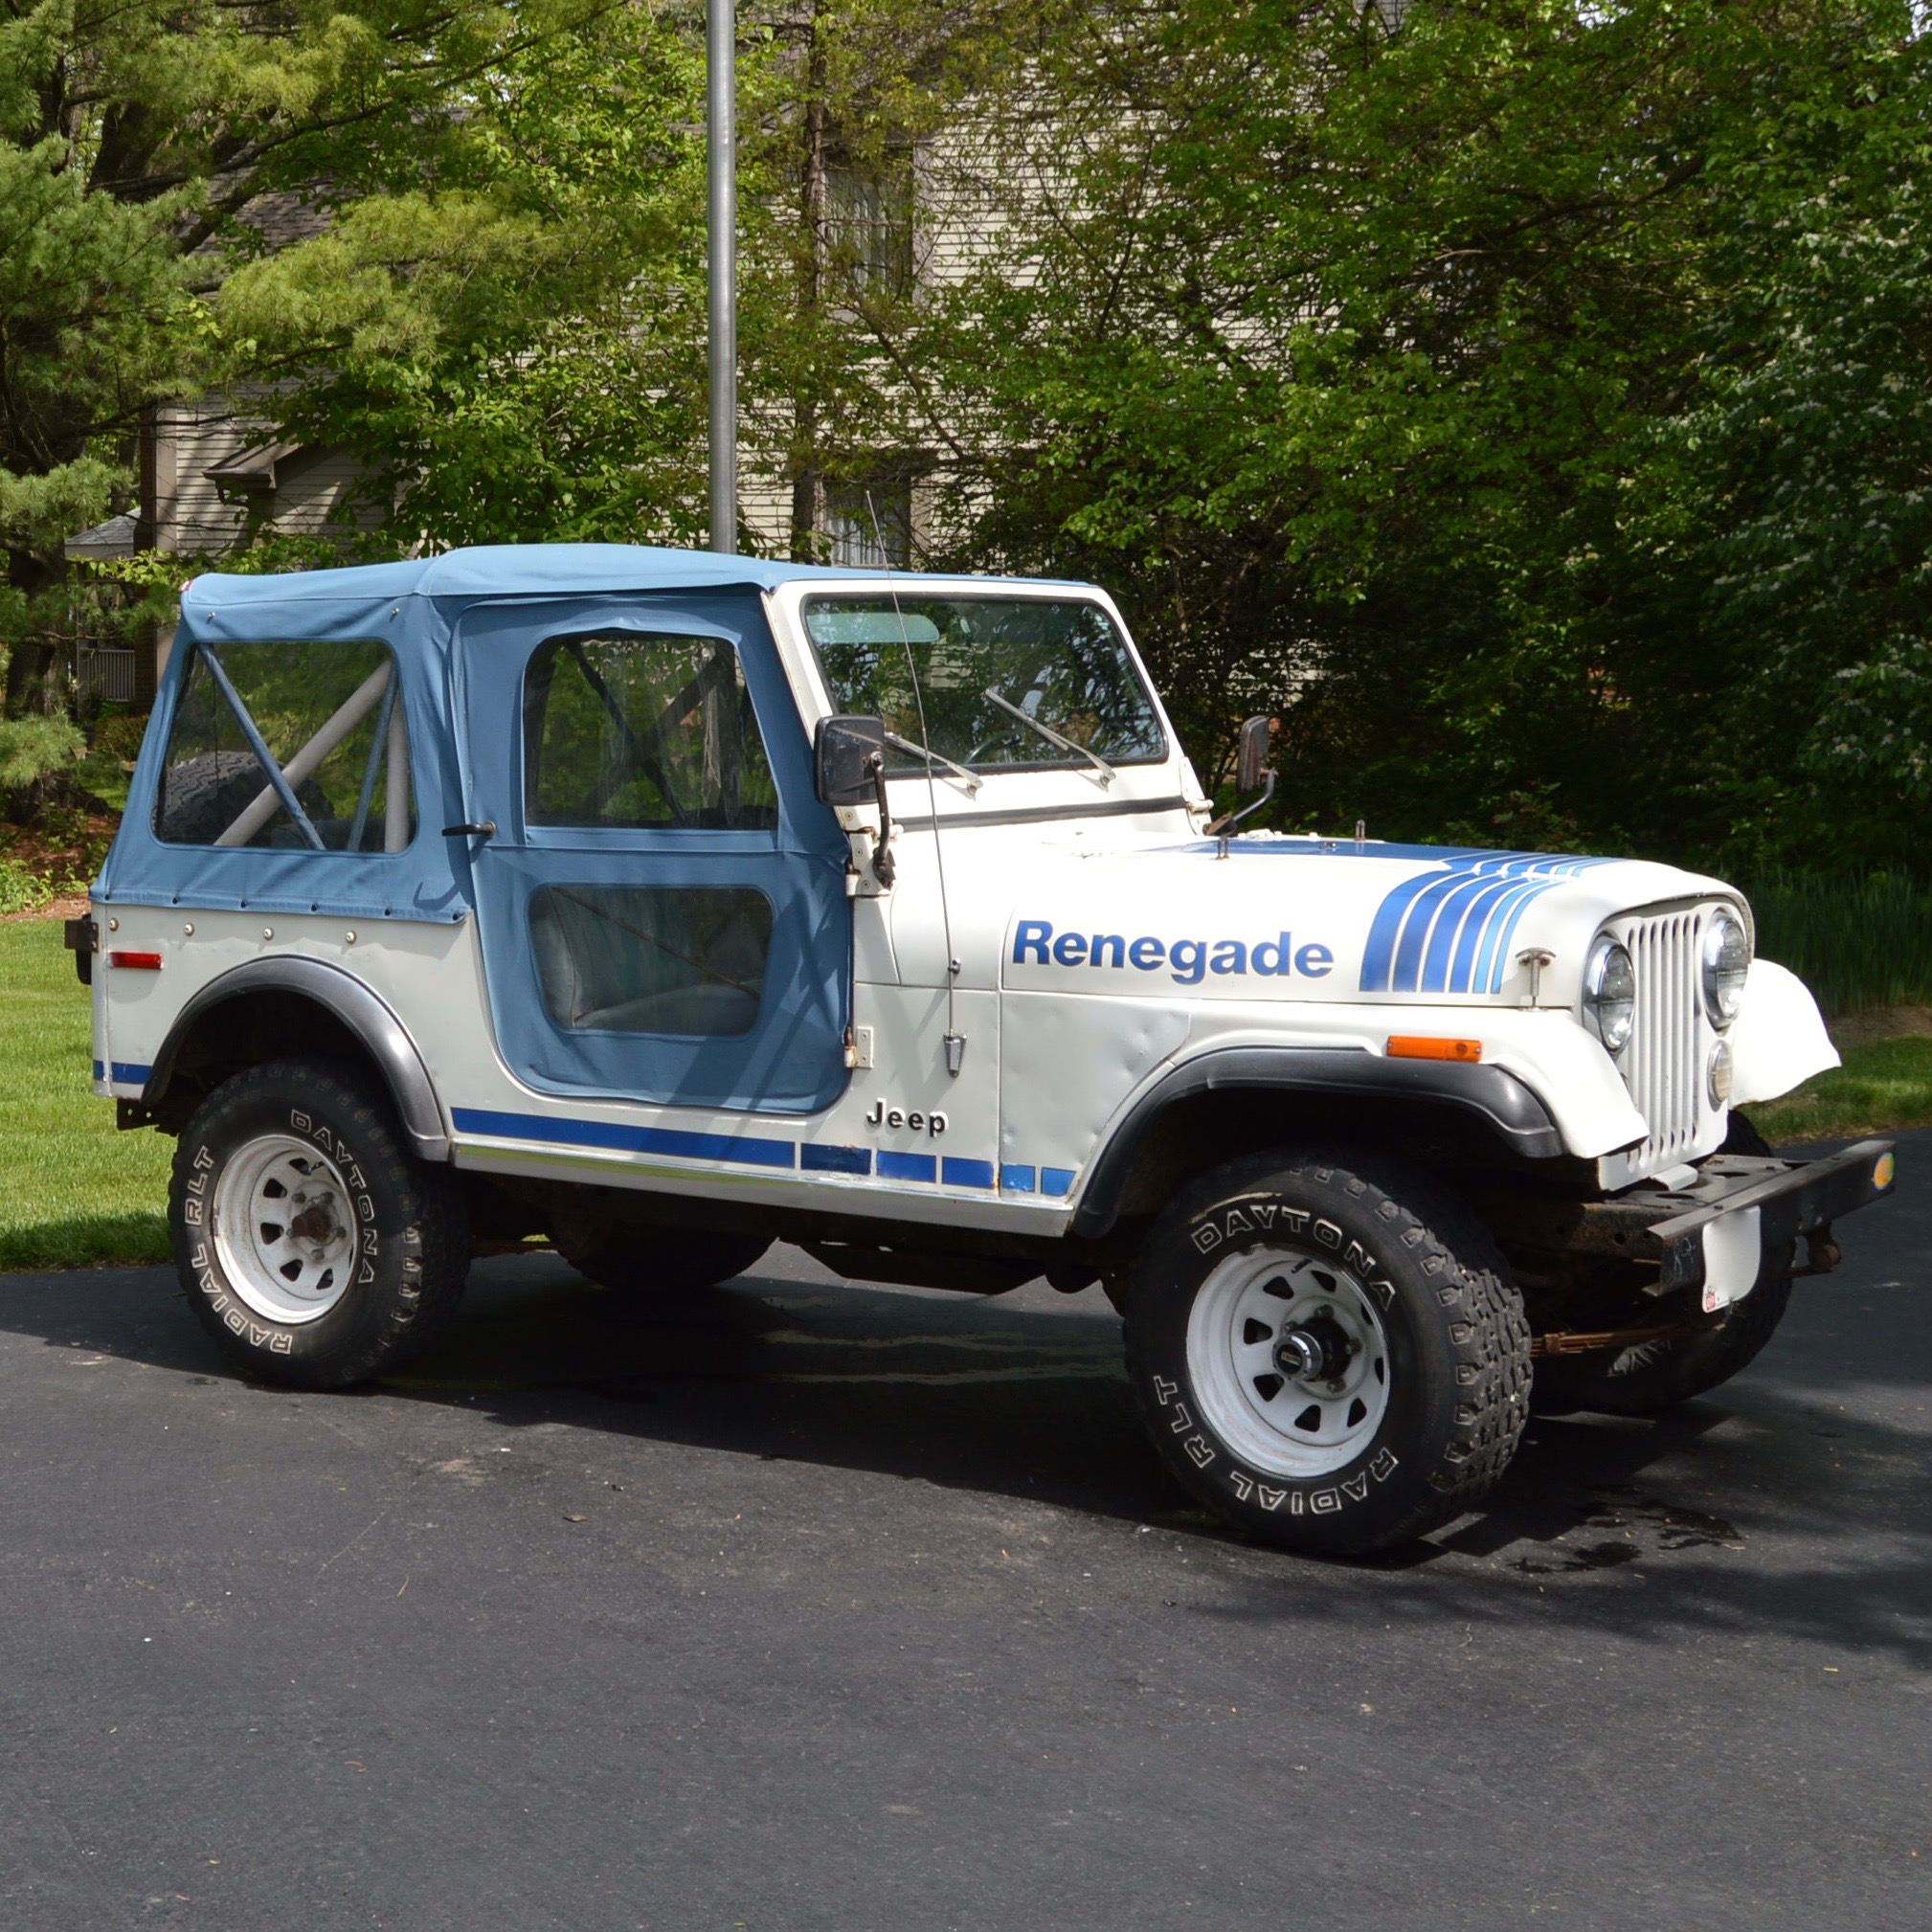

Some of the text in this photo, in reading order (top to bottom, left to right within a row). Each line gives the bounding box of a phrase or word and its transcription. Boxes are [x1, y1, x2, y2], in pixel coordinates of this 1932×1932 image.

[1012, 919, 1335, 985] Renegade
[866, 1097, 949, 1138] Jeep
[185, 1145, 293, 1355] RADIAL RLT
[290, 1109, 377, 1285] DAYTONA
[1191, 1203, 1397, 1313] DAYTONA
[1153, 1375, 1400, 1516] RADIAL RLT
